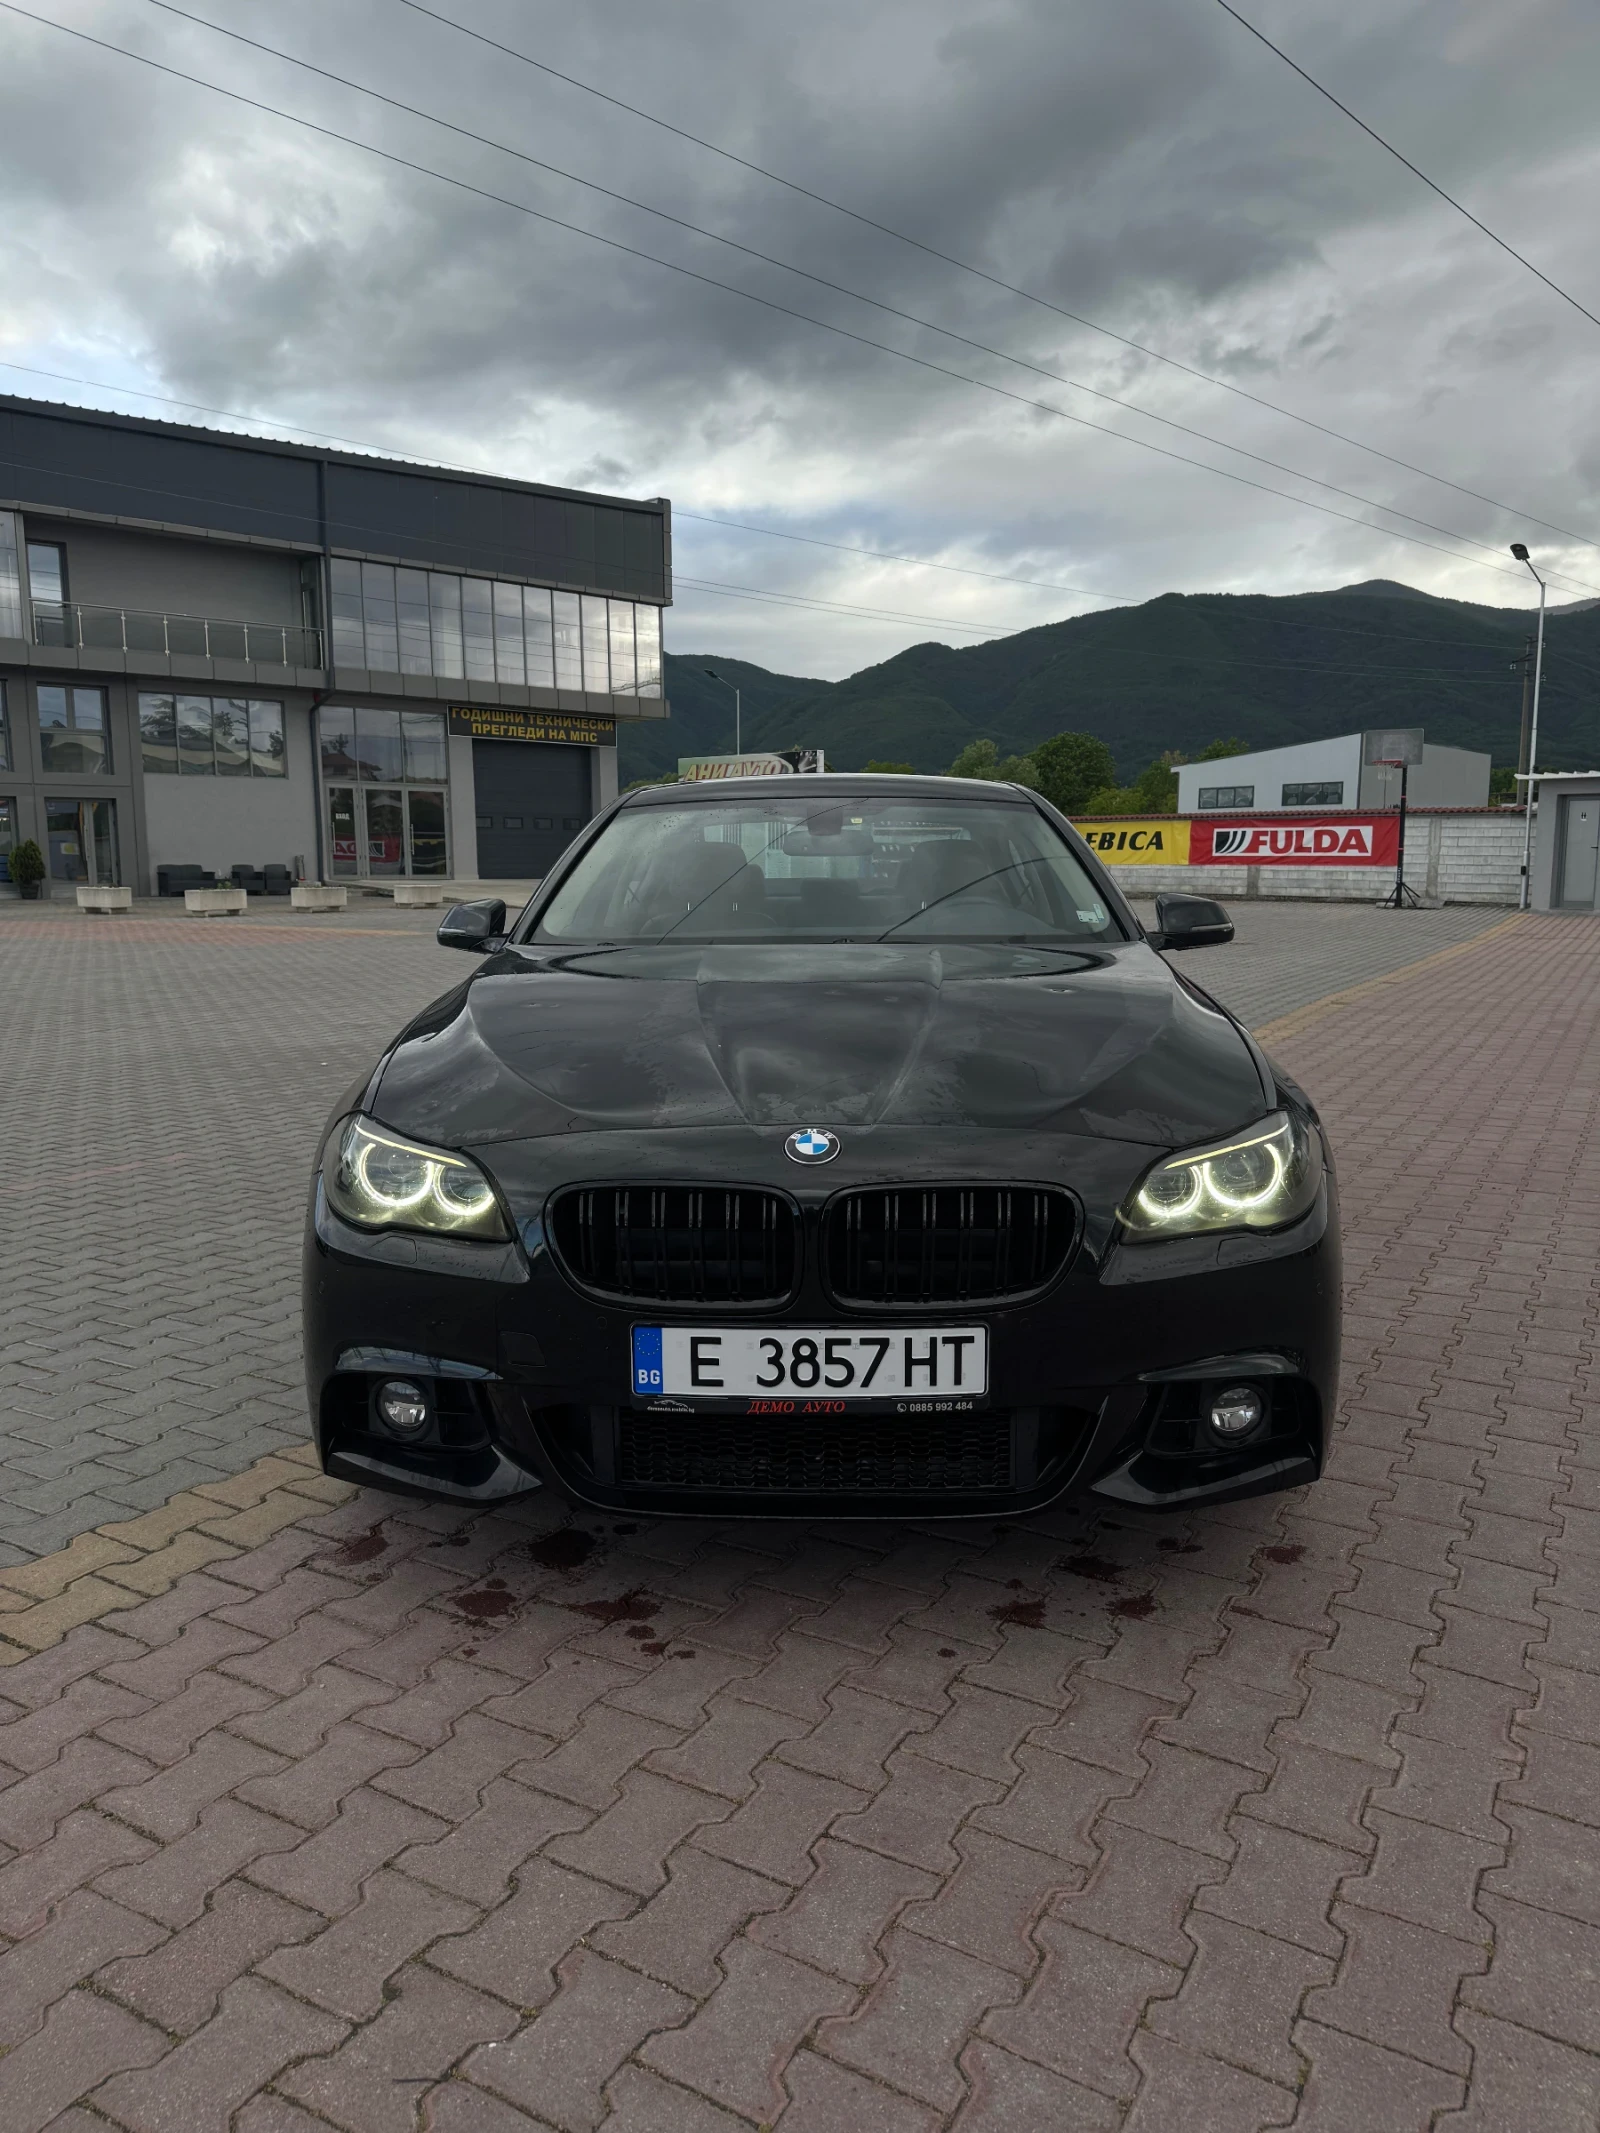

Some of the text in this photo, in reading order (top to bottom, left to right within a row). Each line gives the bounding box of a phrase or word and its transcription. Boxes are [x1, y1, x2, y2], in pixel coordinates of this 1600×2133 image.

[451, 707, 614, 732] ГОДИШНИ ТЕХНИЧЕСКИ
[472, 723, 598, 743] ПРЕГЛЕДИ НА МПС
[1241, 829, 1369, 854] FULDA
[790, 1128, 836, 1140] BMW
[690, 1335, 975, 1388] E 3857 HT
[638, 1368, 661, 1384] BG
[746, 1401, 846, 1415] ДЕМО АУТО
[909, 1401, 973, 1413] 0885 992 484
